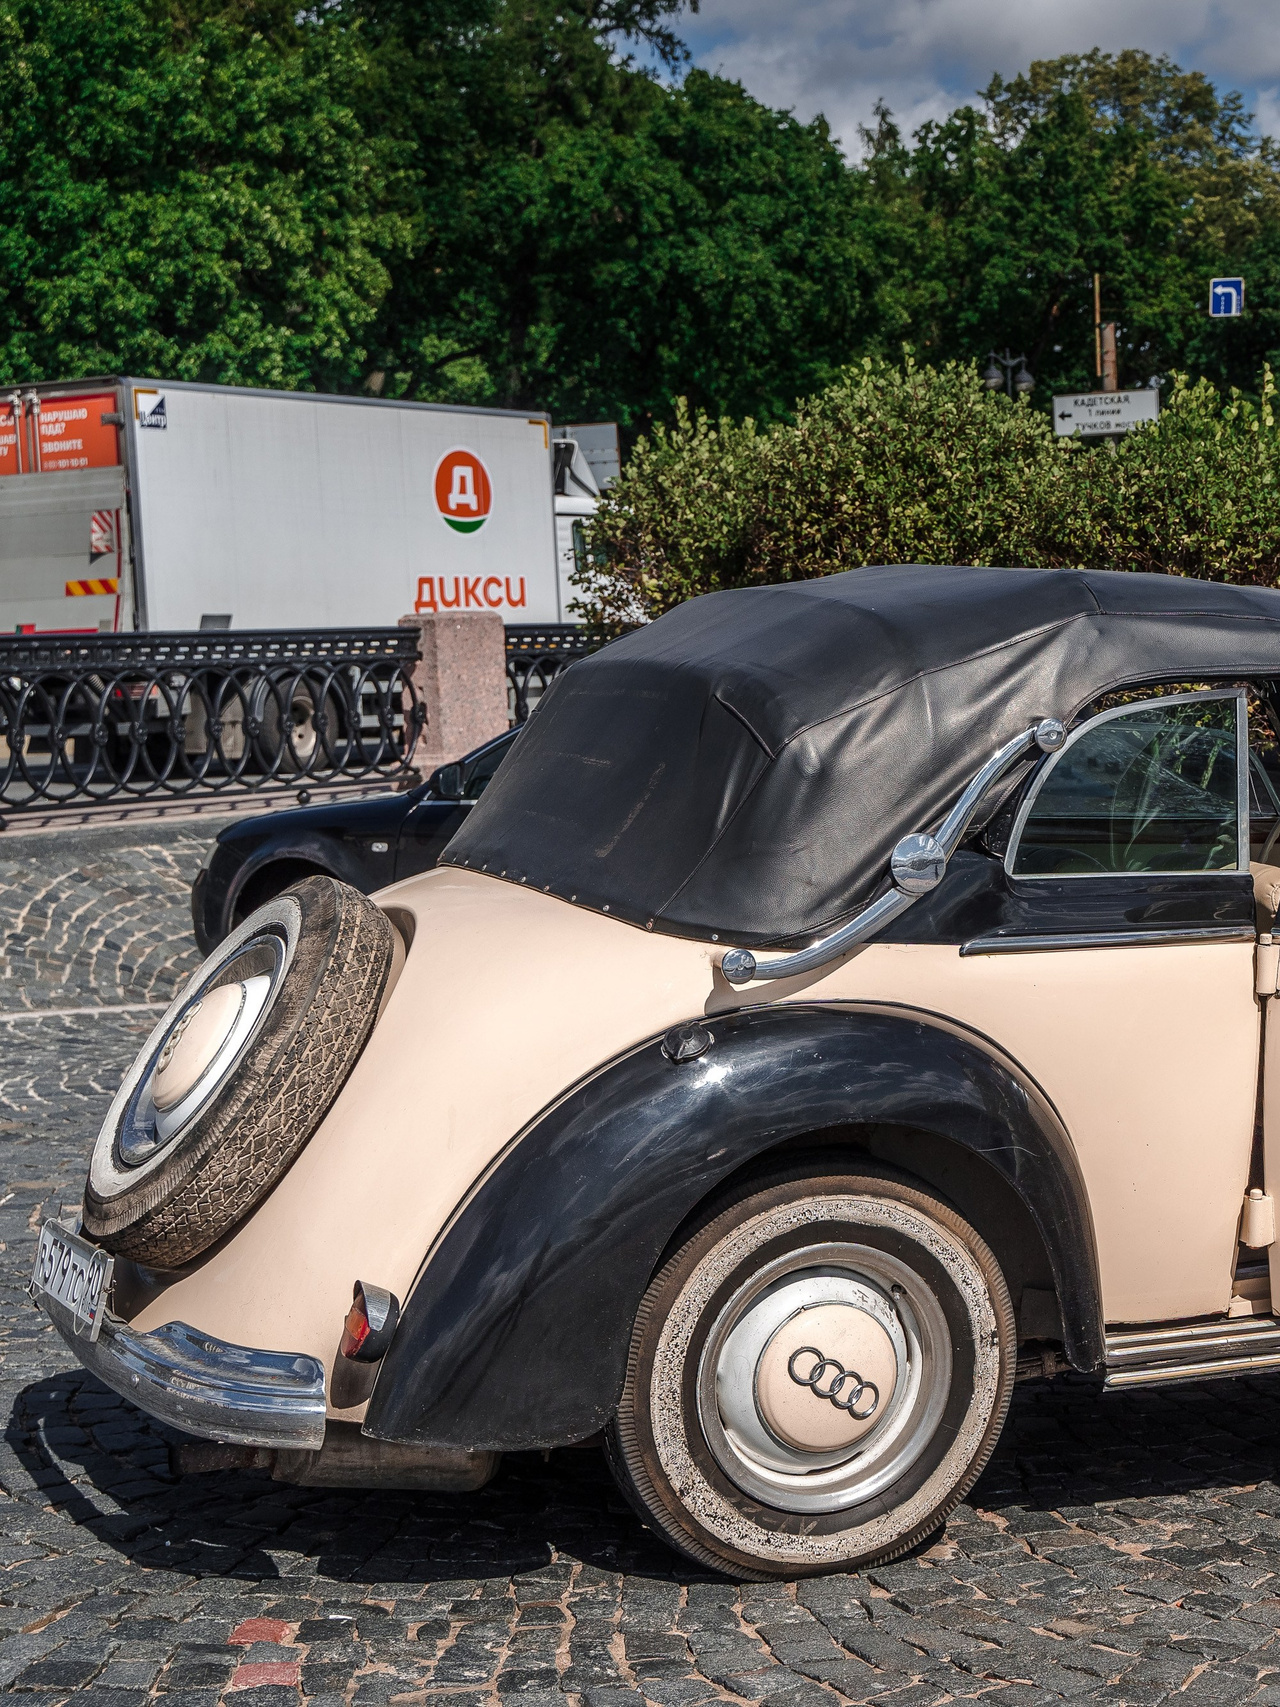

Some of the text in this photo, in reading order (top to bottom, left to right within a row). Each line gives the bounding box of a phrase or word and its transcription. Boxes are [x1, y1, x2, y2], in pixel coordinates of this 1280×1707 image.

[1073, 394, 1131, 408] КАДЕТСКАЯ
[40, 408, 88, 423] НАРУШАЮ
[41, 422, 66, 437] ПДД?
[1075, 420, 1112, 431] ТУЧКОВ
[42, 438, 83, 454] ЗВОНИТЕ
[448, 465, 478, 512] Д
